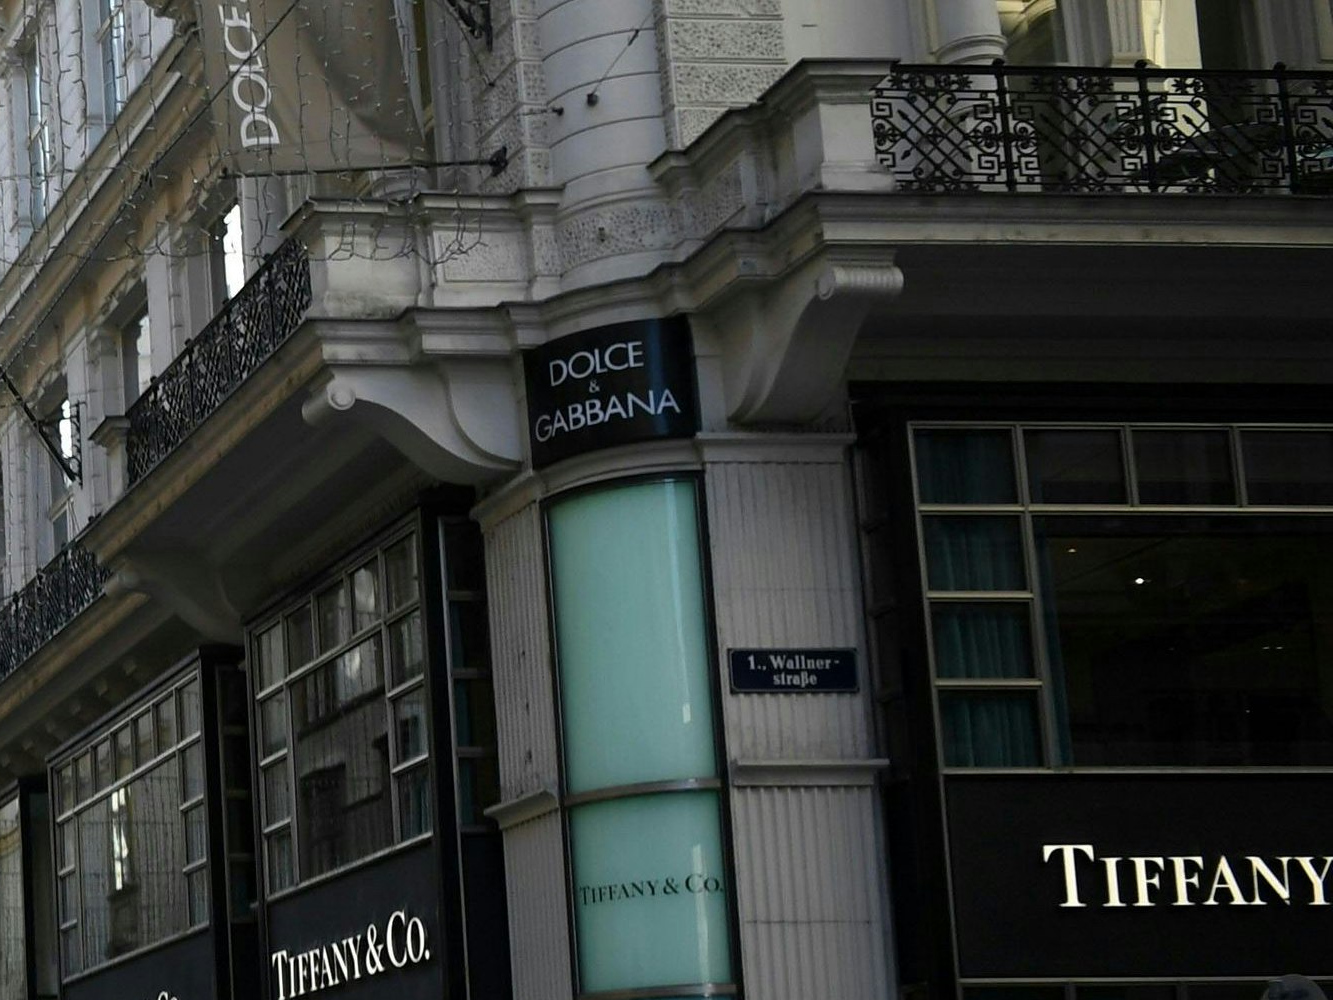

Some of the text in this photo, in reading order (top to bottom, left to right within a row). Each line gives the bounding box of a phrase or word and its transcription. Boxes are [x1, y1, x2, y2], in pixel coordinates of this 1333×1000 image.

[219, 4, 280, 148] DOLCE
[549, 342, 645, 387] DOLCE
[588, 380, 601, 394] &
[535, 388, 681, 443] GABBANA
[769, 655, 840, 670] Wallner-
[773, 671, 818, 688] straße
[580, 880, 658, 905] TIFFANY
[663, 876, 679, 895] &
[1043, 844, 1333, 907] TIFFANY
[366, 923, 385, 975] &
